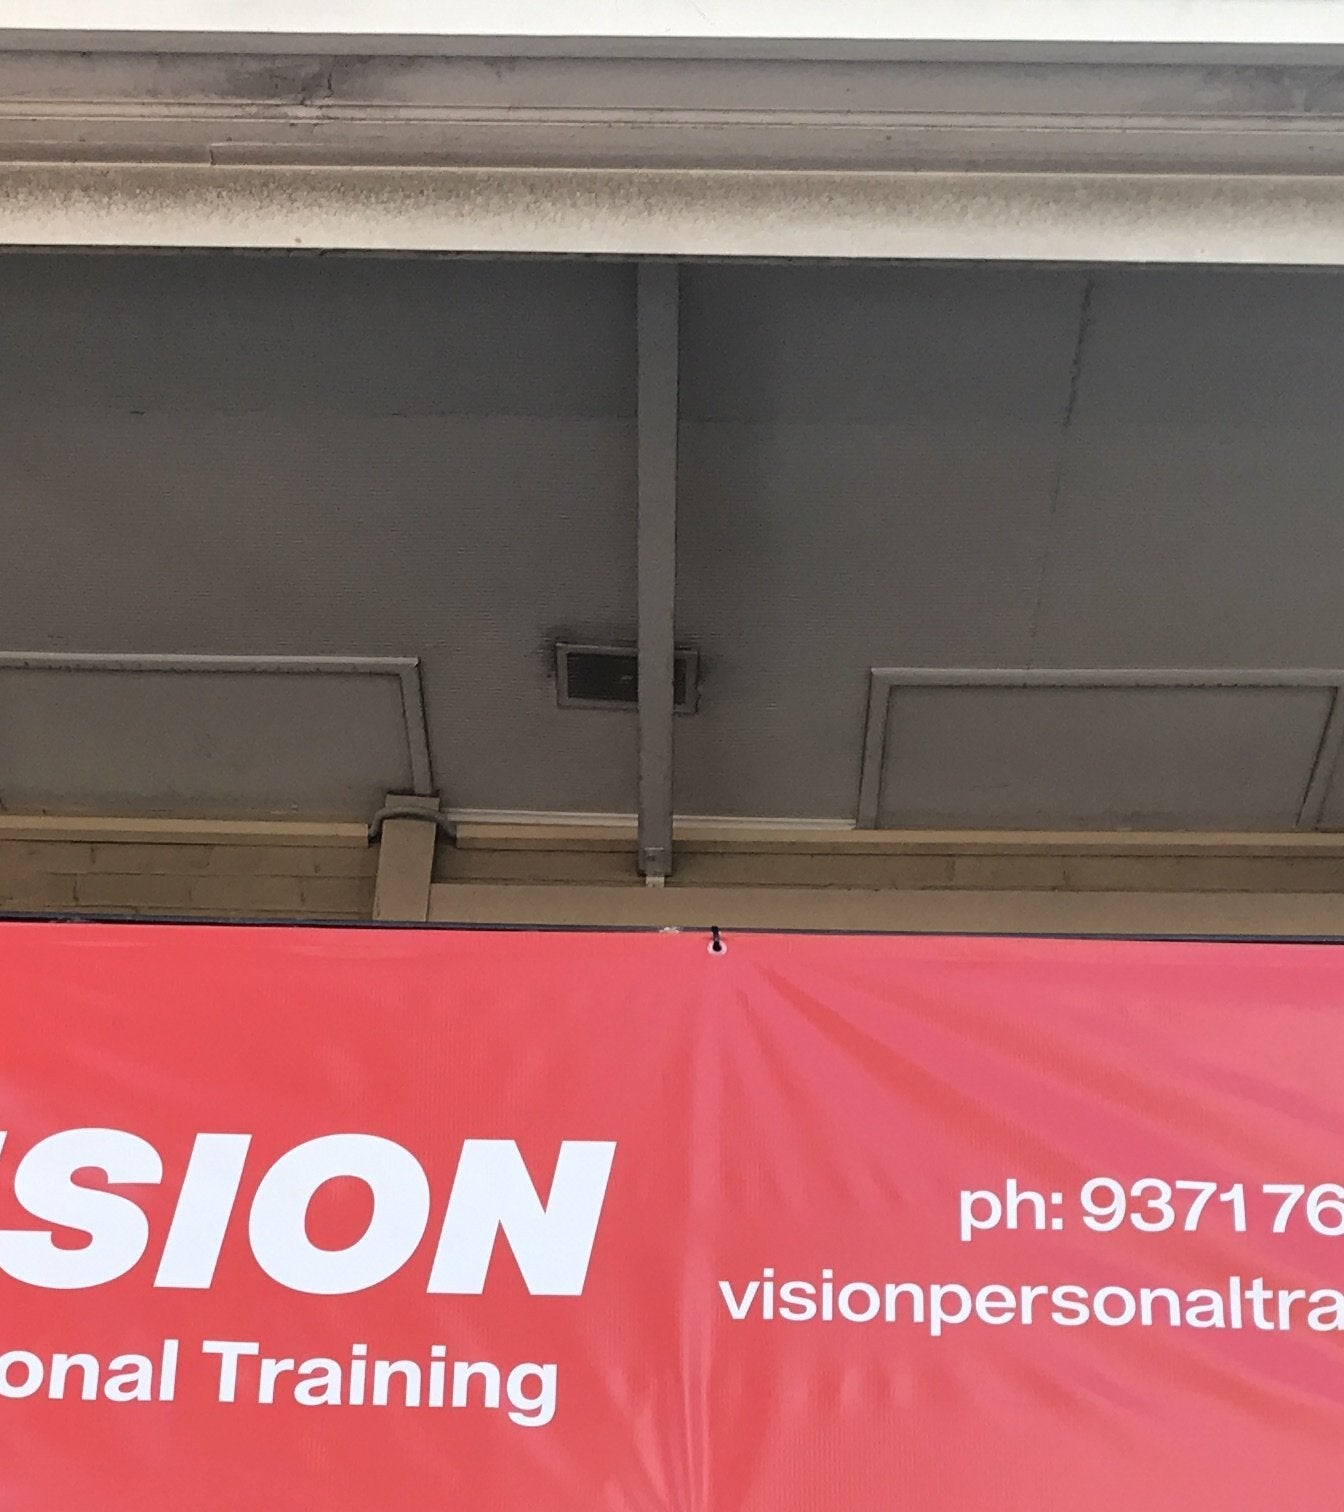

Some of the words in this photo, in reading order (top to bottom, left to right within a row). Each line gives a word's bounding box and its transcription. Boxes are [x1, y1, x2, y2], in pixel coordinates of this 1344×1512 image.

[959, 1178, 1064, 1242] ph:
[1080, 1177, 1247, 1233] 9371
[202, 1340, 558, 1427] Training
